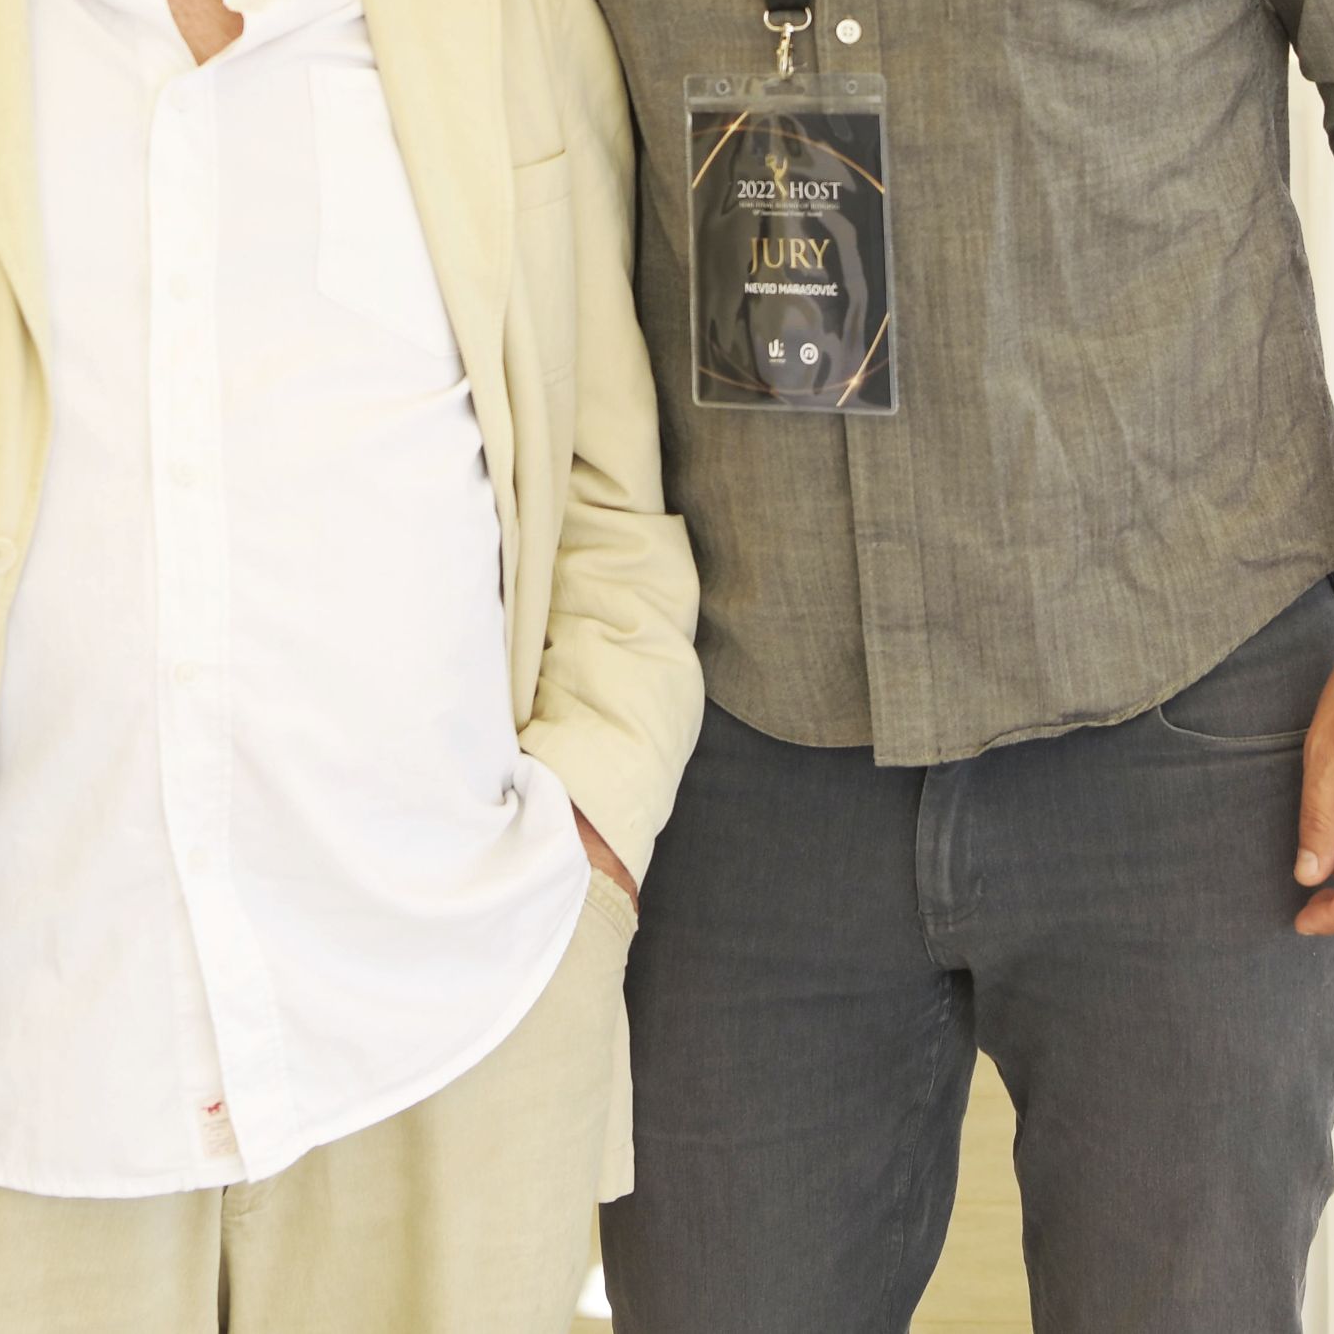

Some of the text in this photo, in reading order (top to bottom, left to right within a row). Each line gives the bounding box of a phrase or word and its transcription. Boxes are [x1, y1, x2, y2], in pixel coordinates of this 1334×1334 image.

[737, 179, 842, 200] 2022 HOST
[750, 237, 830, 275] JURY
